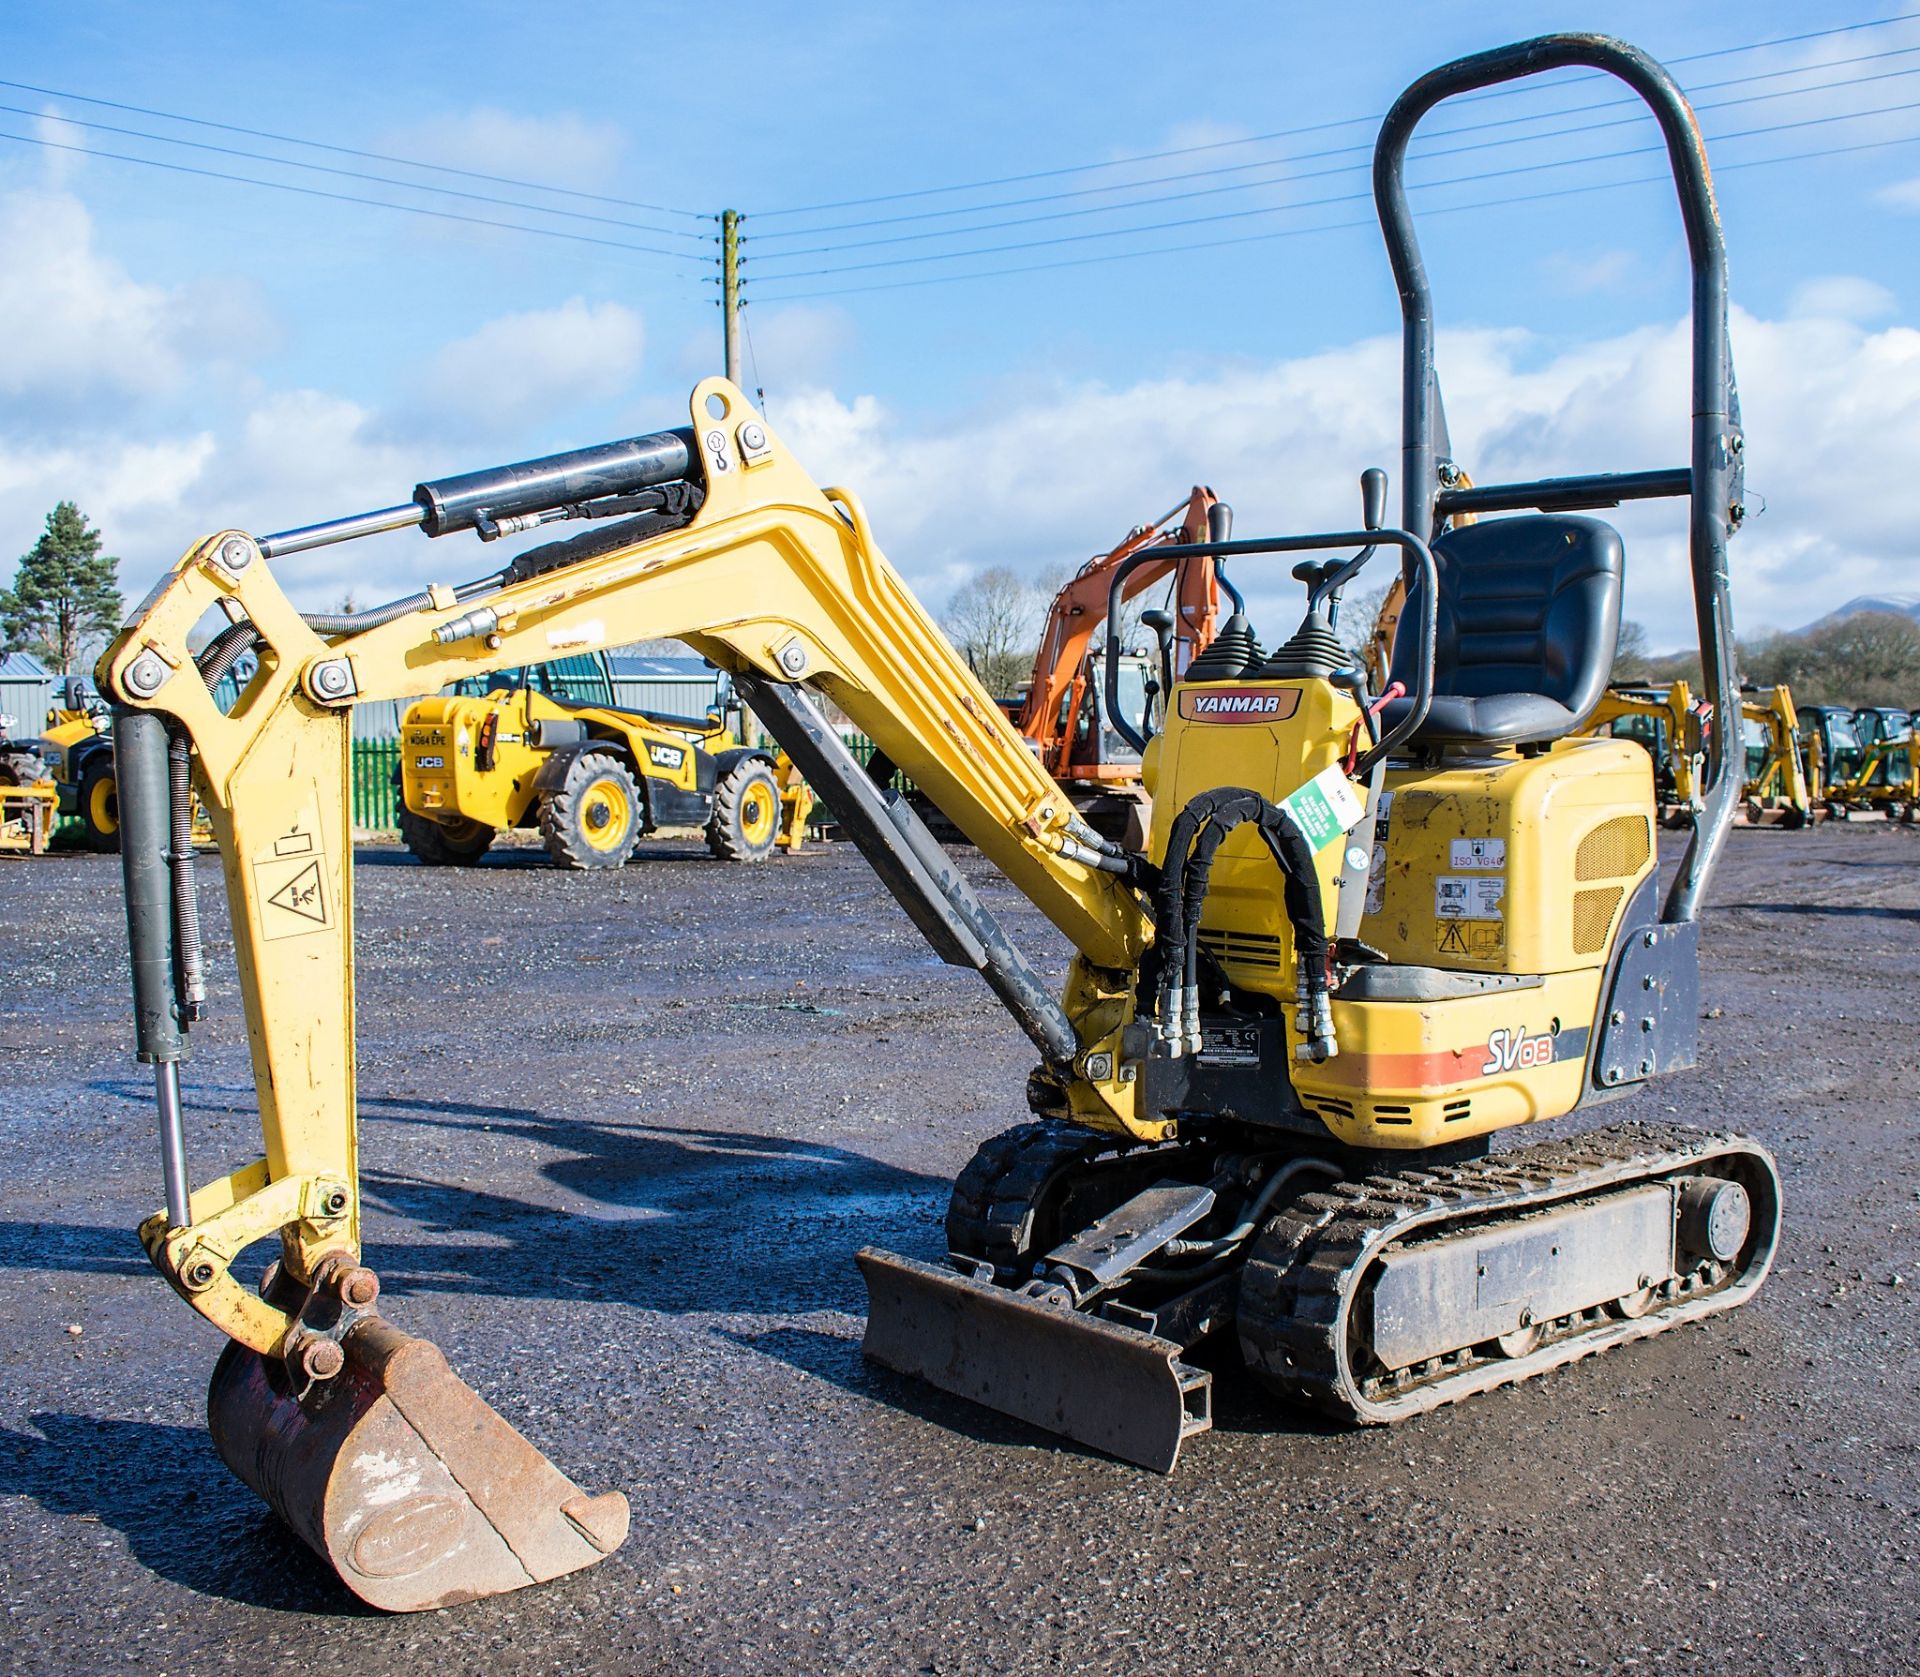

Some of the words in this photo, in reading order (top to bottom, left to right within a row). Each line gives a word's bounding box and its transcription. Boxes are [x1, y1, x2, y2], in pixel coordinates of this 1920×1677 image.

[1195, 696, 1280, 712] YANMAR
[416, 757, 443, 768] JCB
[651, 745, 682, 766] JCB
[1307, 795, 1325, 823] MACHINE
[1297, 806, 1318, 837] APPROVED
[1454, 857, 1472, 866] ISO
[1482, 1025, 1552, 1076] SV08
